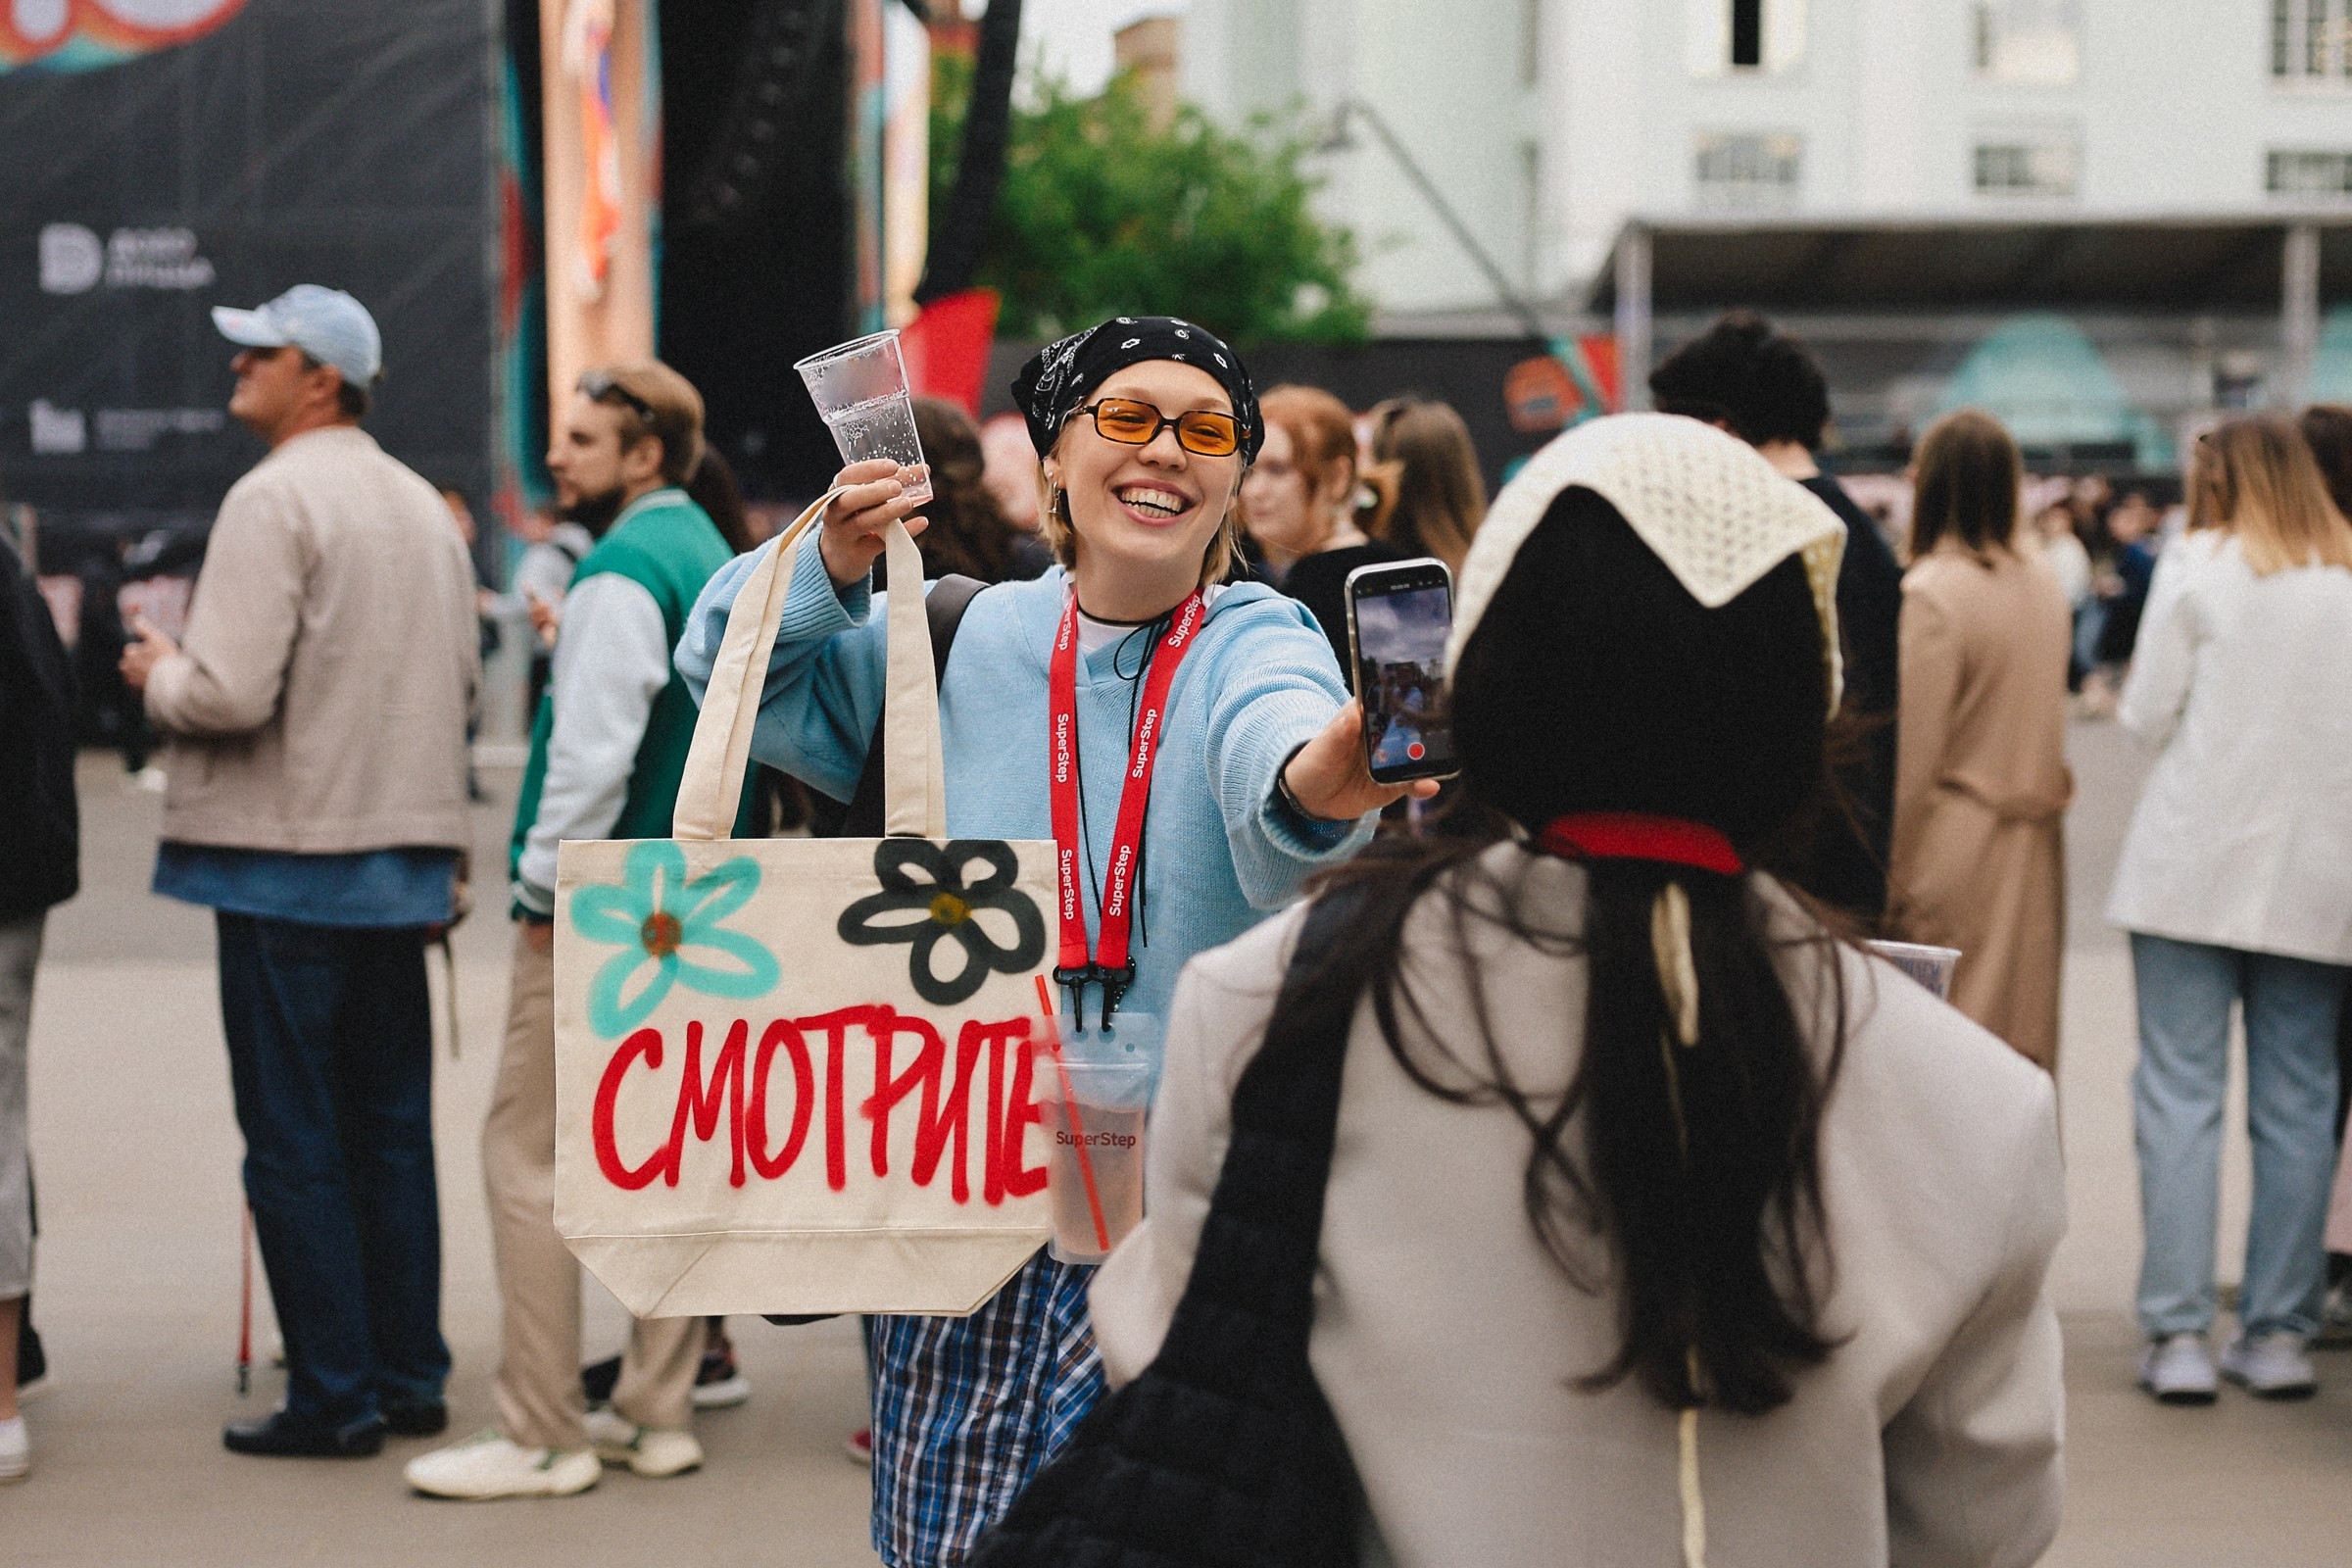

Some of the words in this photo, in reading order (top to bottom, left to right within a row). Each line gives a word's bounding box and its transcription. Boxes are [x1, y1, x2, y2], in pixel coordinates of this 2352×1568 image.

[1055, 713, 1070, 783] SuperStep
[1132, 709, 1158, 779] SuperStep
[1060, 849, 1075, 920] SuperStep
[1108, 845, 1132, 916] SuperStep
[1055, 1131, 1137, 1150] SuperStep
